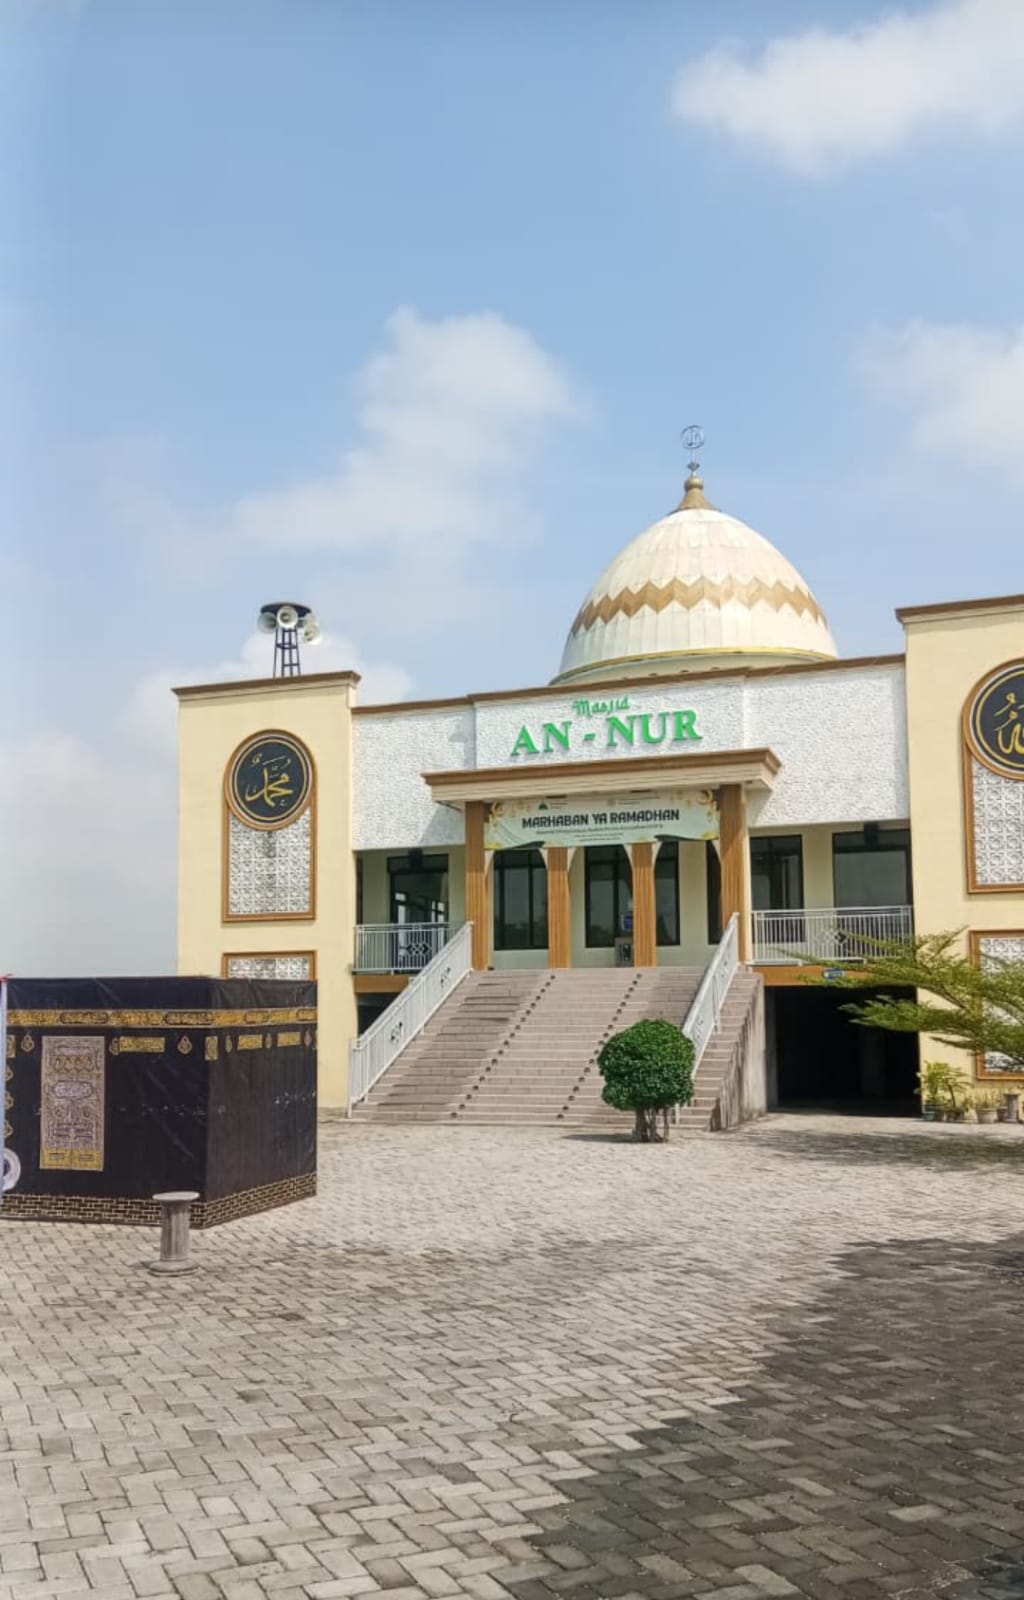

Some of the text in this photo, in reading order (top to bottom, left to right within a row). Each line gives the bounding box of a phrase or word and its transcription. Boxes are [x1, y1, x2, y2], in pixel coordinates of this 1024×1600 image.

[572, 696, 630, 718] Masjid
[511, 721, 572, 756] AN
[606, 709, 703, 747] NUR
[522, 814, 588, 829] MARHABAN
[593, 812, 608, 824] YA
[610, 809, 680, 822] RAMADHAN
